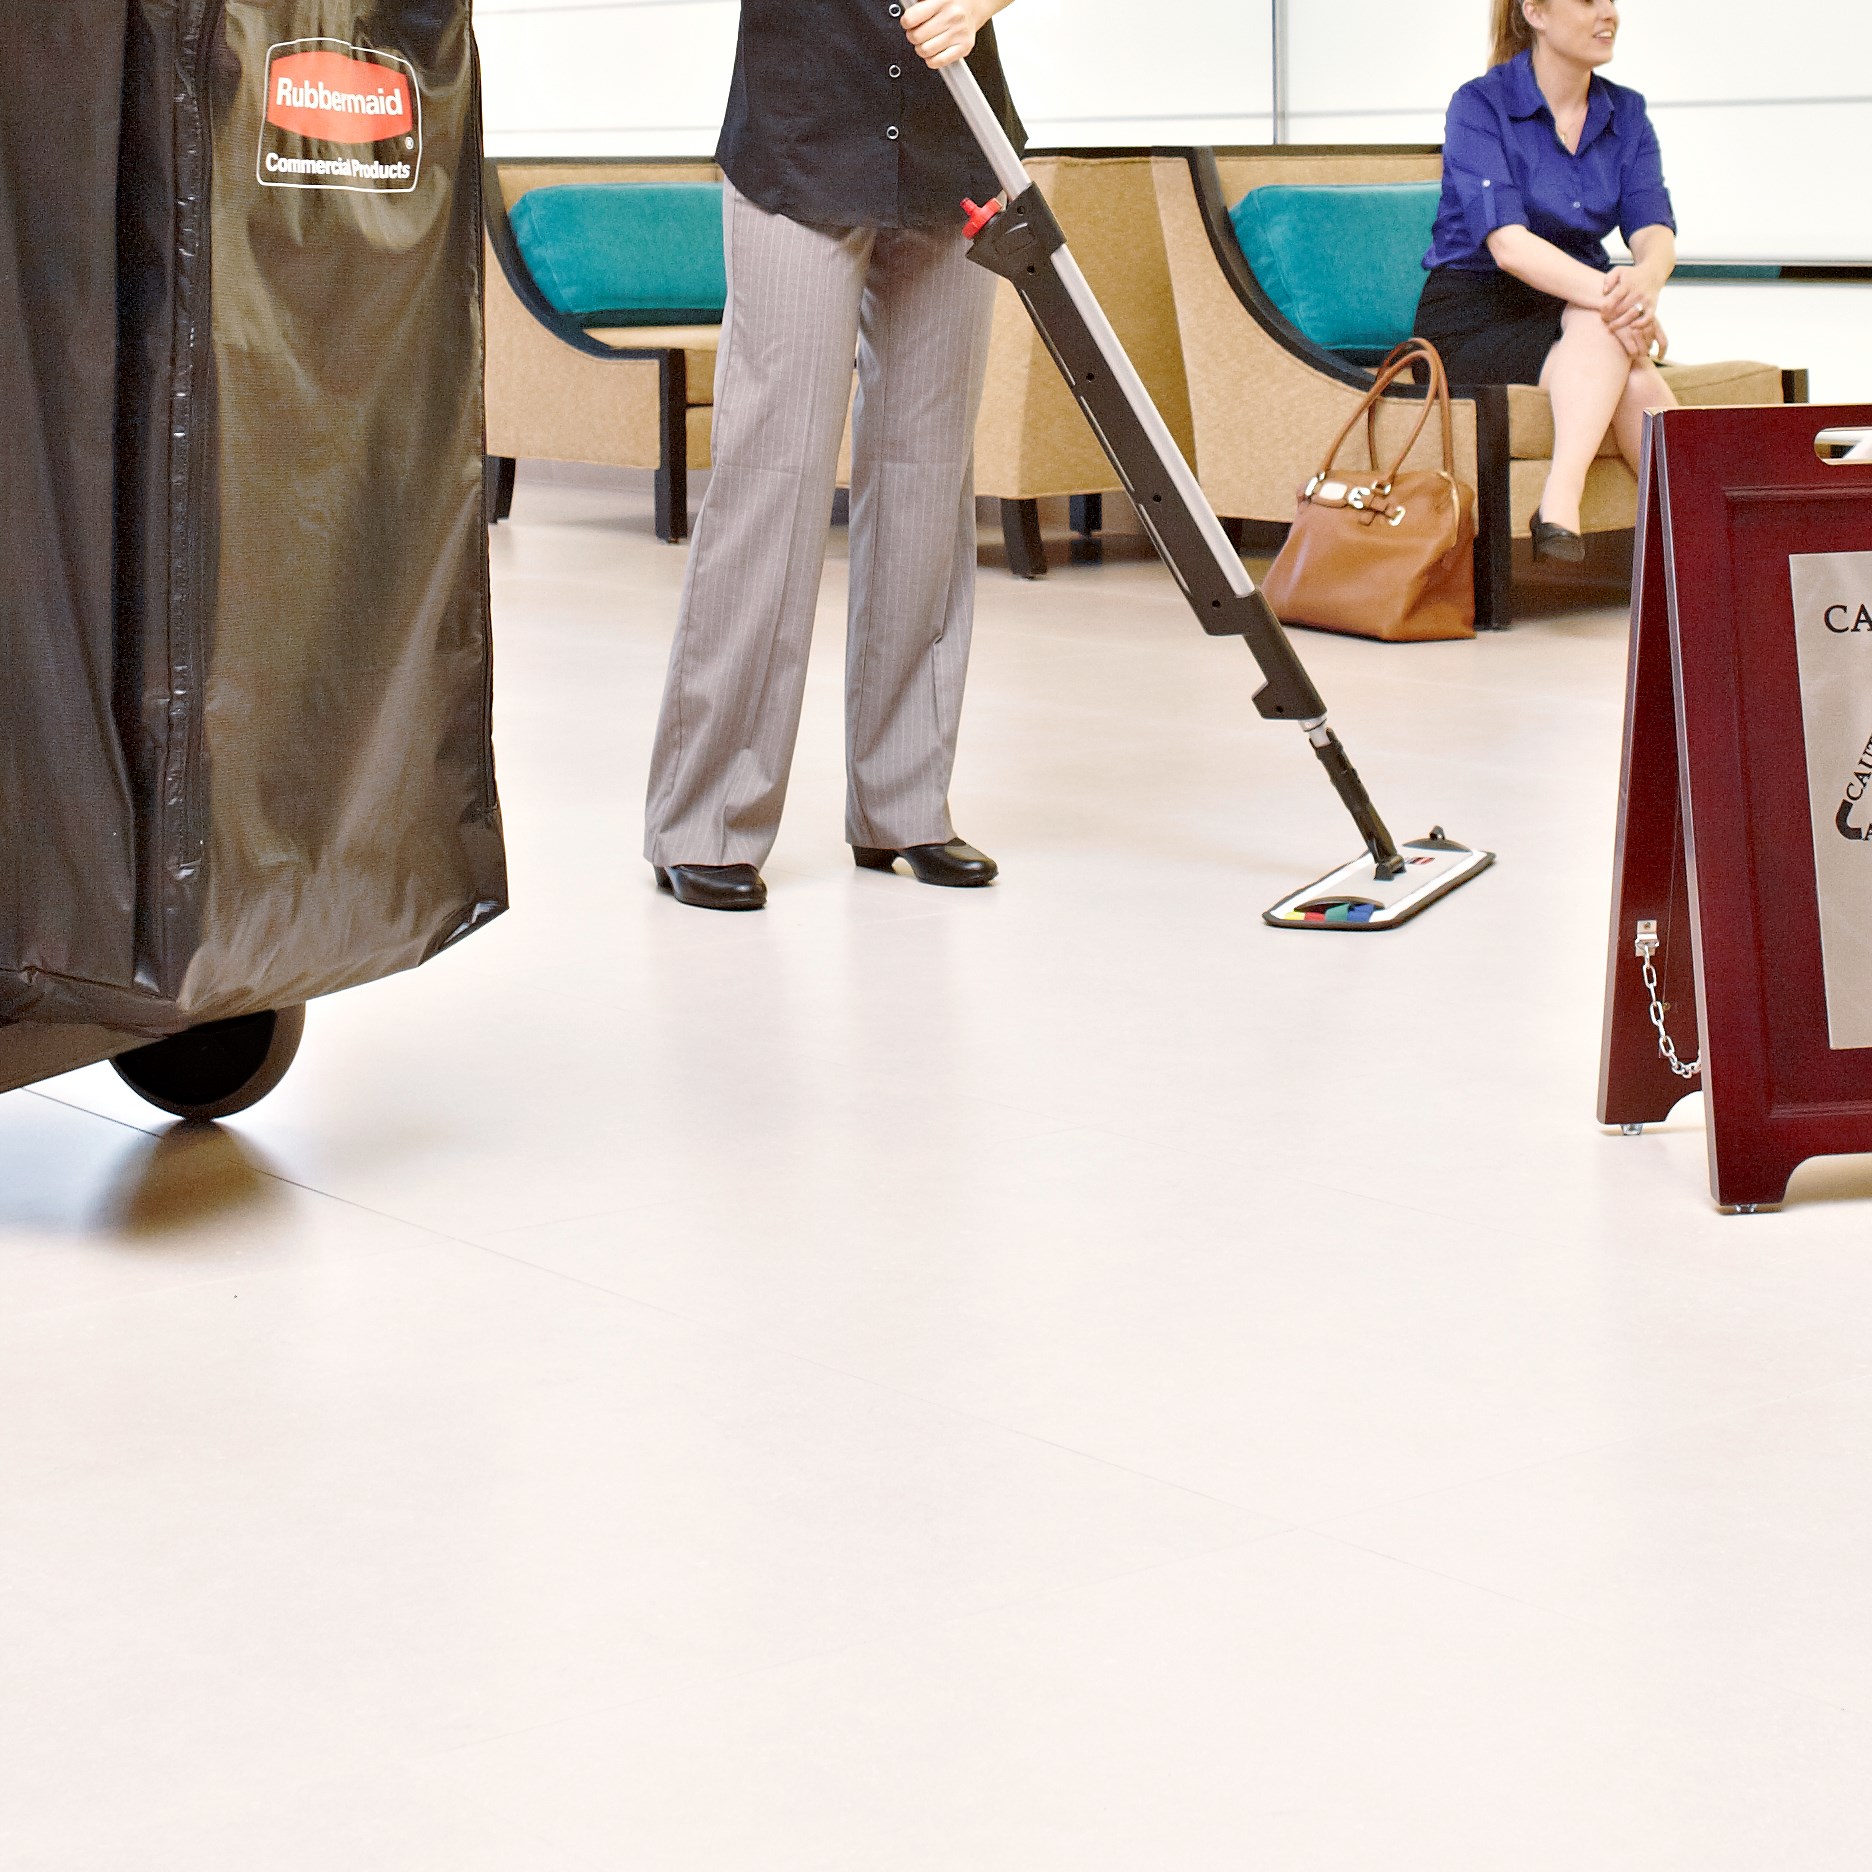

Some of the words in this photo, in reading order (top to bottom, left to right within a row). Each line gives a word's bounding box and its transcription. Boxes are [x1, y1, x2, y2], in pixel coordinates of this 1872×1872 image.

[276, 77, 403, 115] Rubbermaid
[265, 152, 351, 177] Commercial
[352, 158, 412, 179] Products
